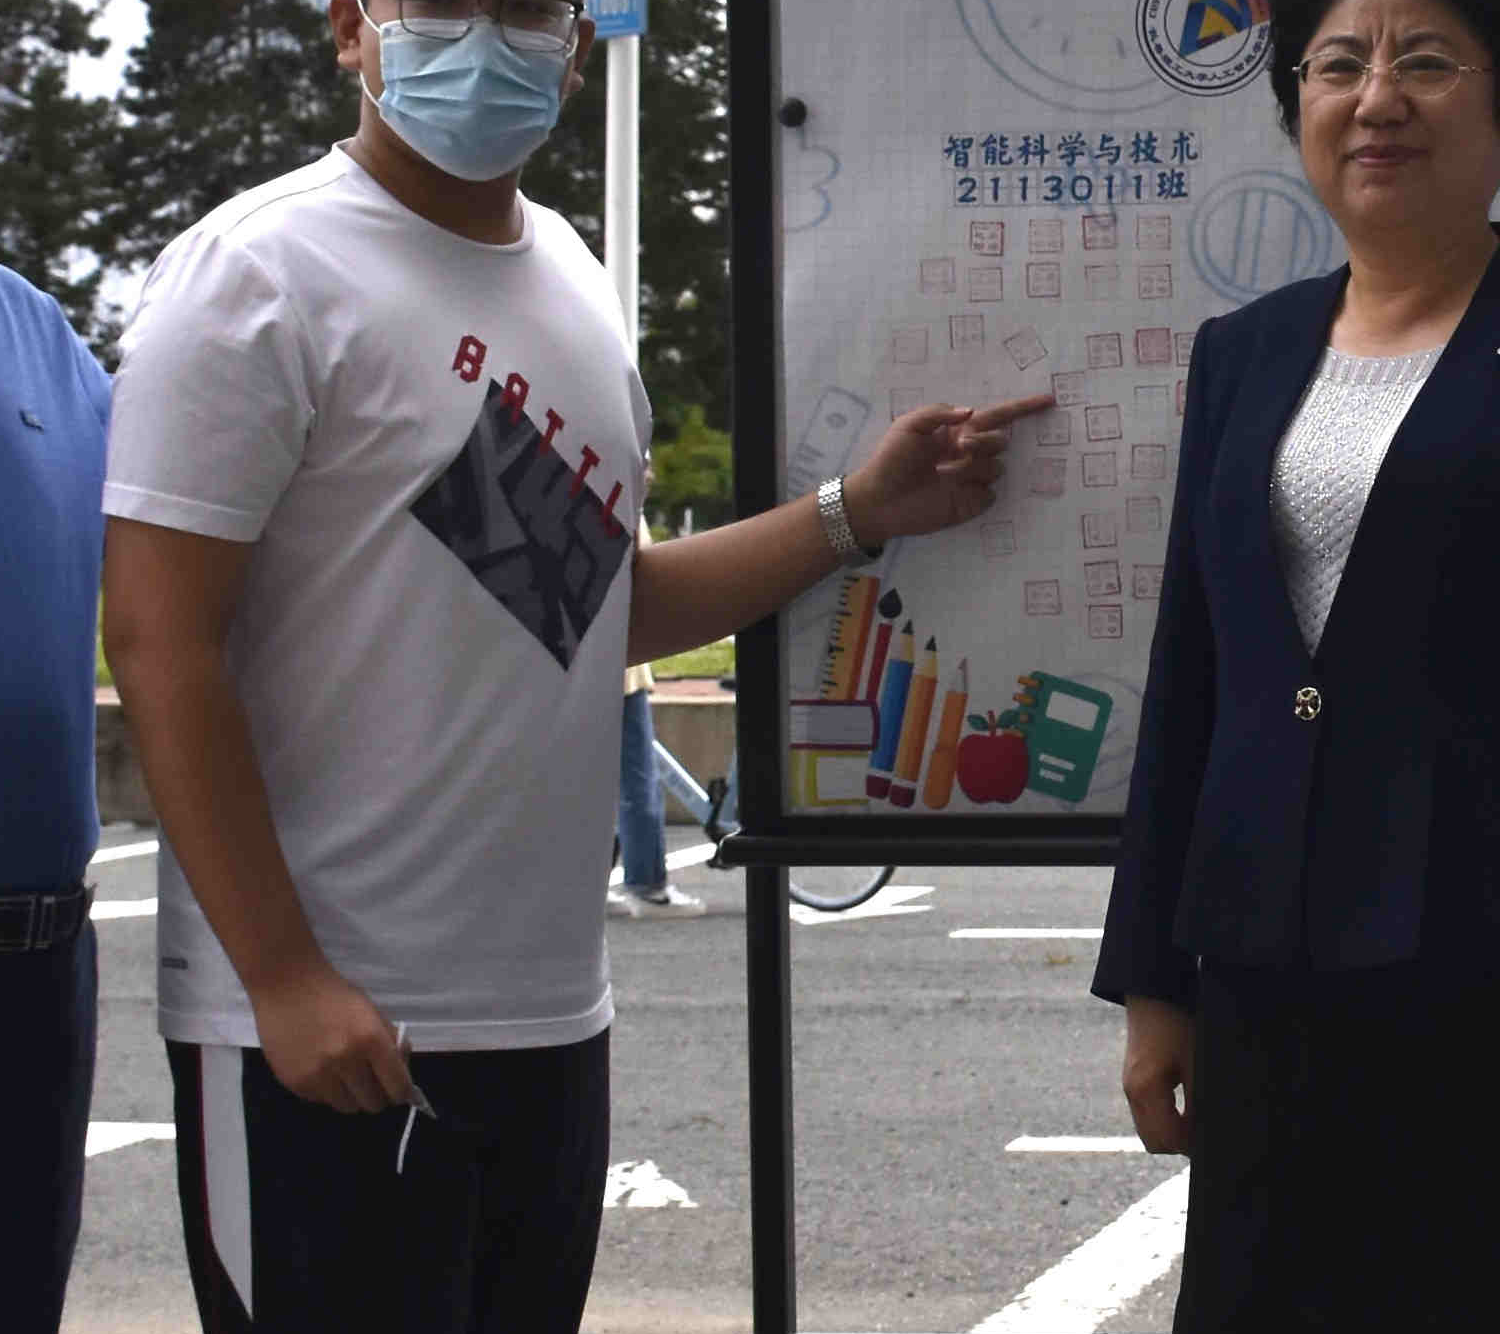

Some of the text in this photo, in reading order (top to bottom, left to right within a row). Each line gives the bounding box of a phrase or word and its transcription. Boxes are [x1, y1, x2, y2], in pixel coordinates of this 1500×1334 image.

[943, 131, 1199, 167] 智能科学与技术
[957, 168, 1189, 204] 2113011班
